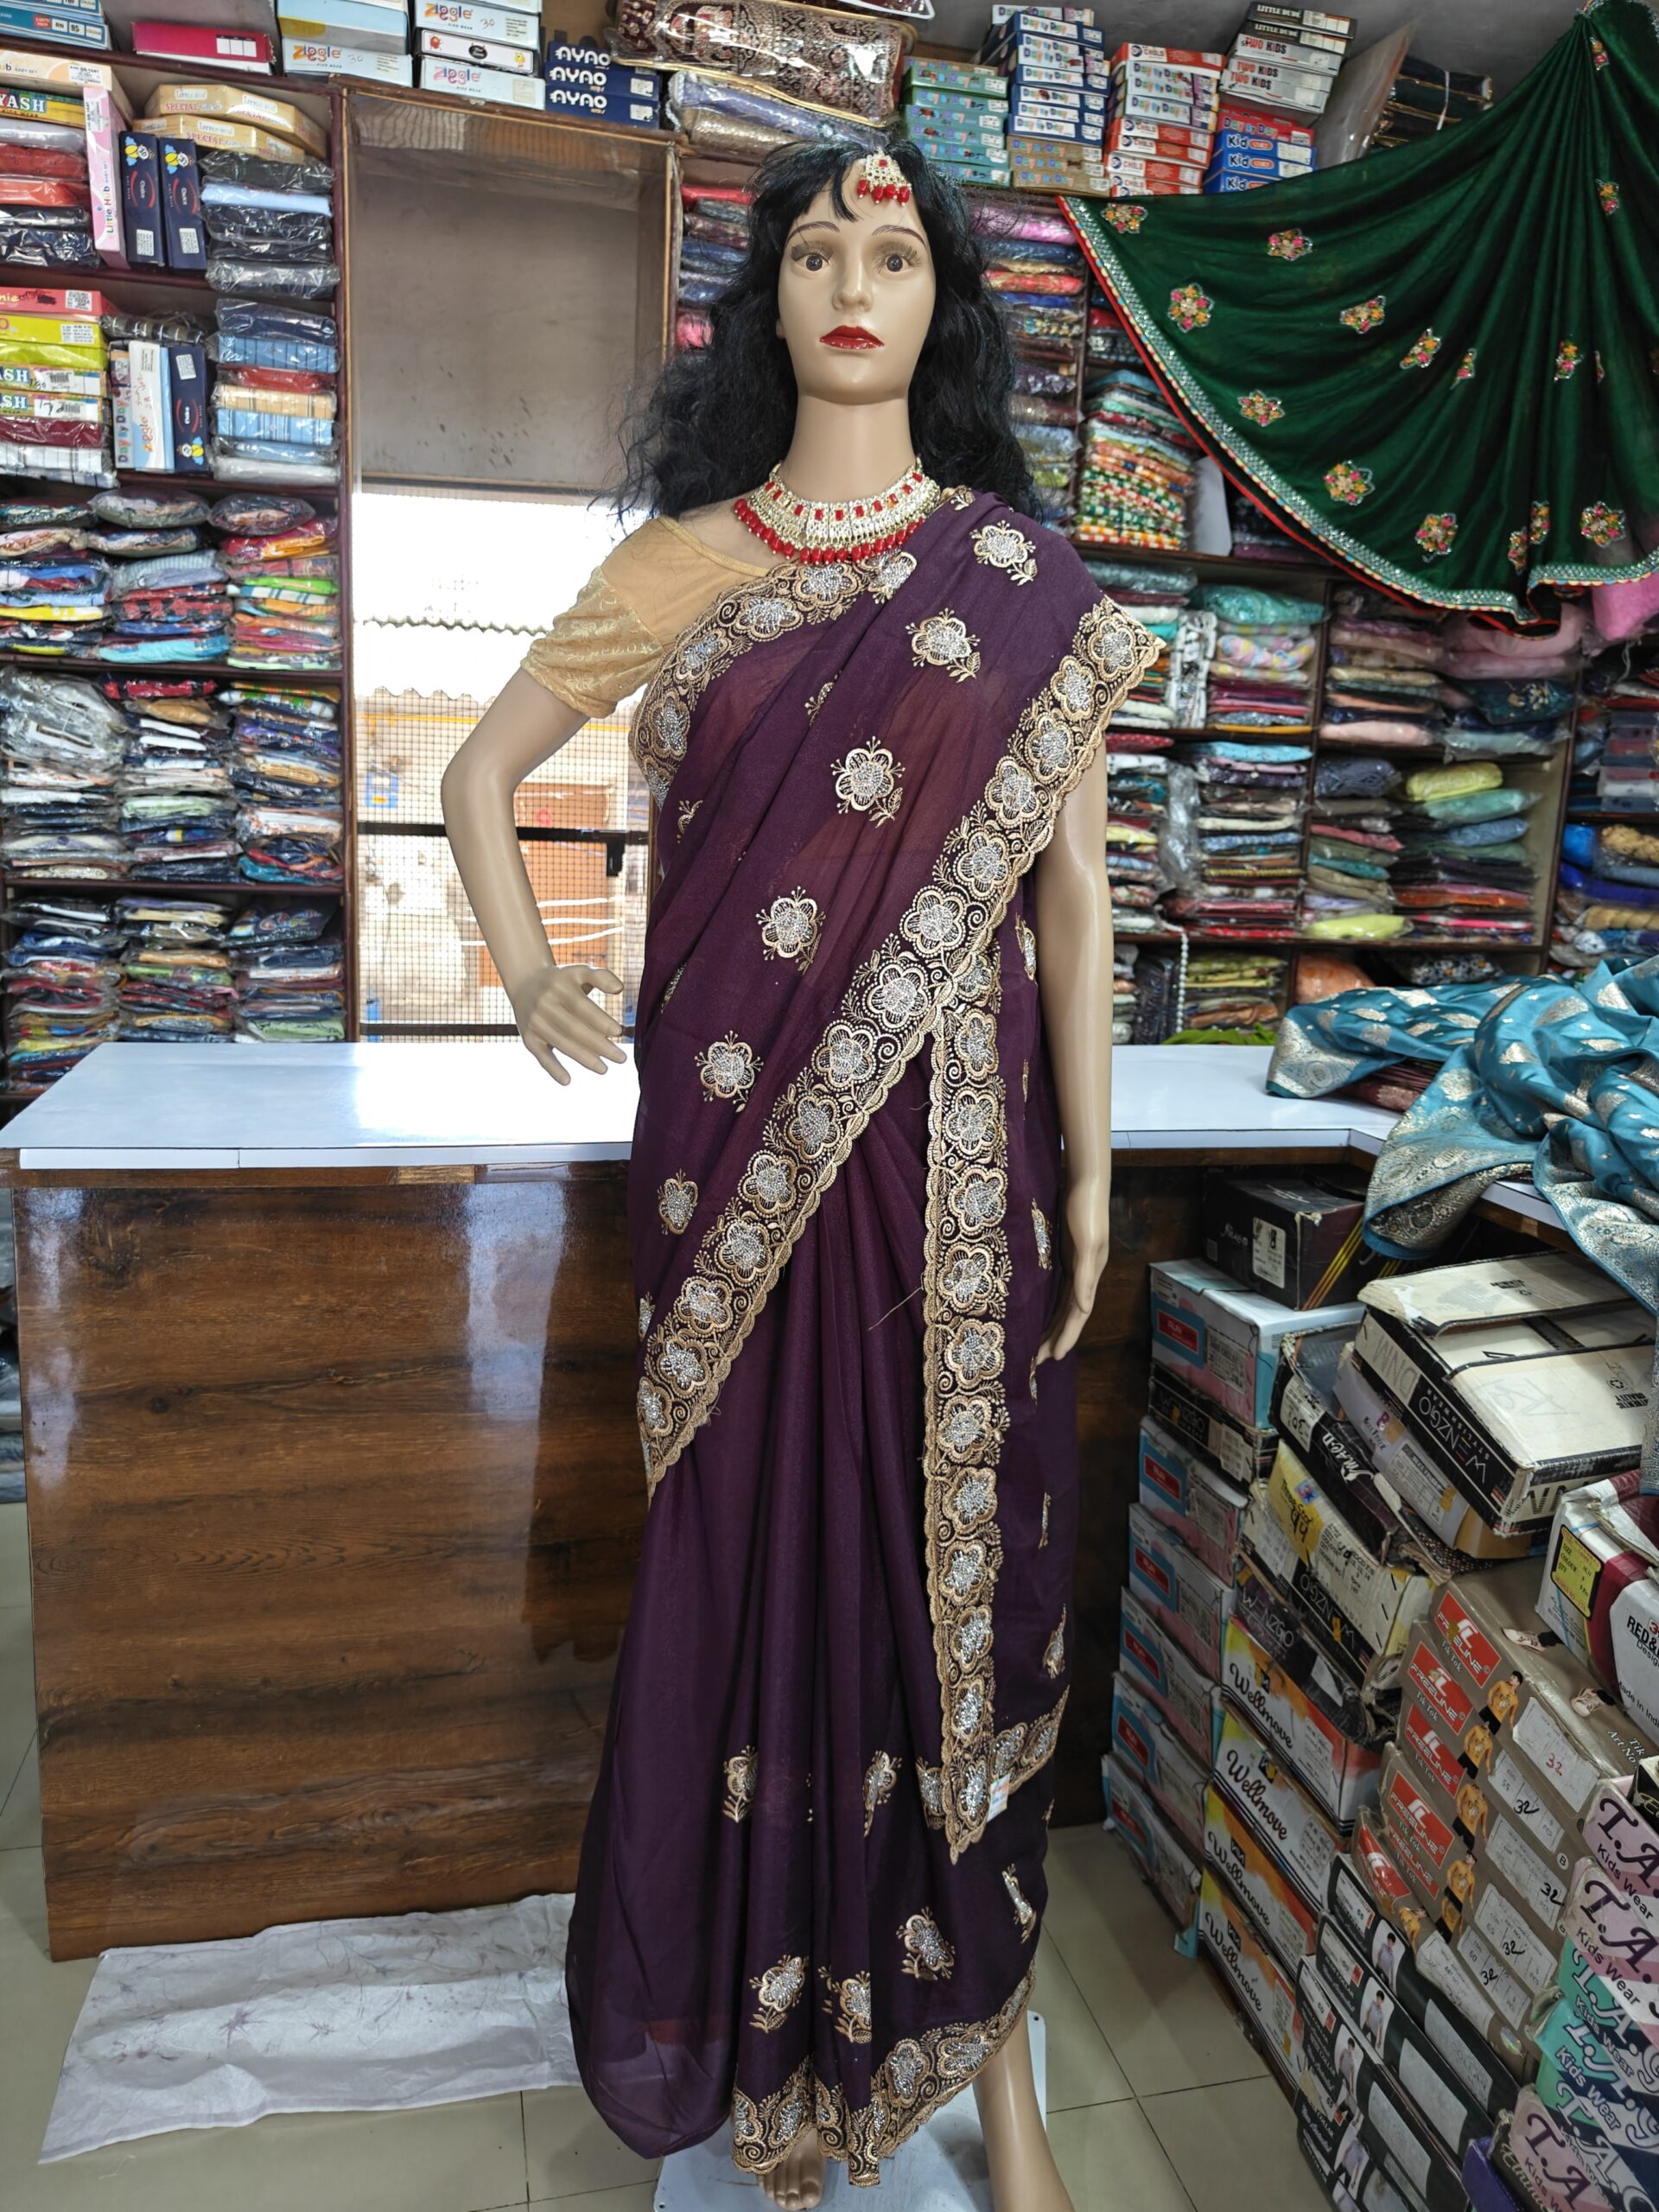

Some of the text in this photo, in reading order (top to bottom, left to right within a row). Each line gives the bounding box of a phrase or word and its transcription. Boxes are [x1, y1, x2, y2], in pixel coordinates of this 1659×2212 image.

[1257, 4, 1281, 14] LITTLE
[1255, 23, 1279, 33] LITTLE
[555, 47, 611, 67] AYAO
[1245, 37, 1287, 54] TWO KIDS
[549, 67, 607, 86] AYAO
[1230, 72, 1271, 90] TWO KIDS
[1237, 61, 1278, 77] TWO KIDS
[550, 90, 607, 108] AYAO
[186, 132, 224, 145] SPECIAL
[1227, 135, 1248, 148] Kid
[1230, 153, 1249, 168] Kid
[1226, 178, 1247, 190] Kid
[105, 208, 114, 233] Little
[1627, 1615, 1649, 1643] RED
[1438, 1611, 1483, 1674] FRELINE
[1637, 1640, 1659, 1666] Desig
[1441, 1640, 1463, 1672] Tik Tok
[1411, 1663, 1458, 1721] FREELINE
[1230, 1662, 1293, 1750] Wellmove
[1416, 1690, 1439, 1721] Tik Tok
[1407, 1724, 1452, 1784] FREELINE
[1607, 1729, 1637, 1764] Art No
[1629, 1738, 1645, 1756] Tik
[1415, 1752, 1436, 1783] Tik Tok
[1546, 1752, 1563, 1776] 32
[1226, 1750, 1287, 1840] Wellmove
[1514, 1799, 1540, 1814] 32
[1389, 1793, 1438, 1855] FREELINE
[1399, 1820, 1421, 1853] Tik Tok
[1208, 1831, 1270, 1926] Wellmove
[1597, 1843, 1654, 1920] Kids Wear
[1541, 1882, 1565, 1907] 32
[1502, 1941, 1525, 1955] 32
[1205, 1912, 1262, 2012] Wellmove
[1576, 1926, 1641, 2005] Kids Wear
[1480, 1968, 1499, 1986] 32
[1602, 2032, 1635, 2076] Wear
[1554, 2045, 1621, 2131] Kids Wear
[1524, 2158, 1548, 2196] Kids
